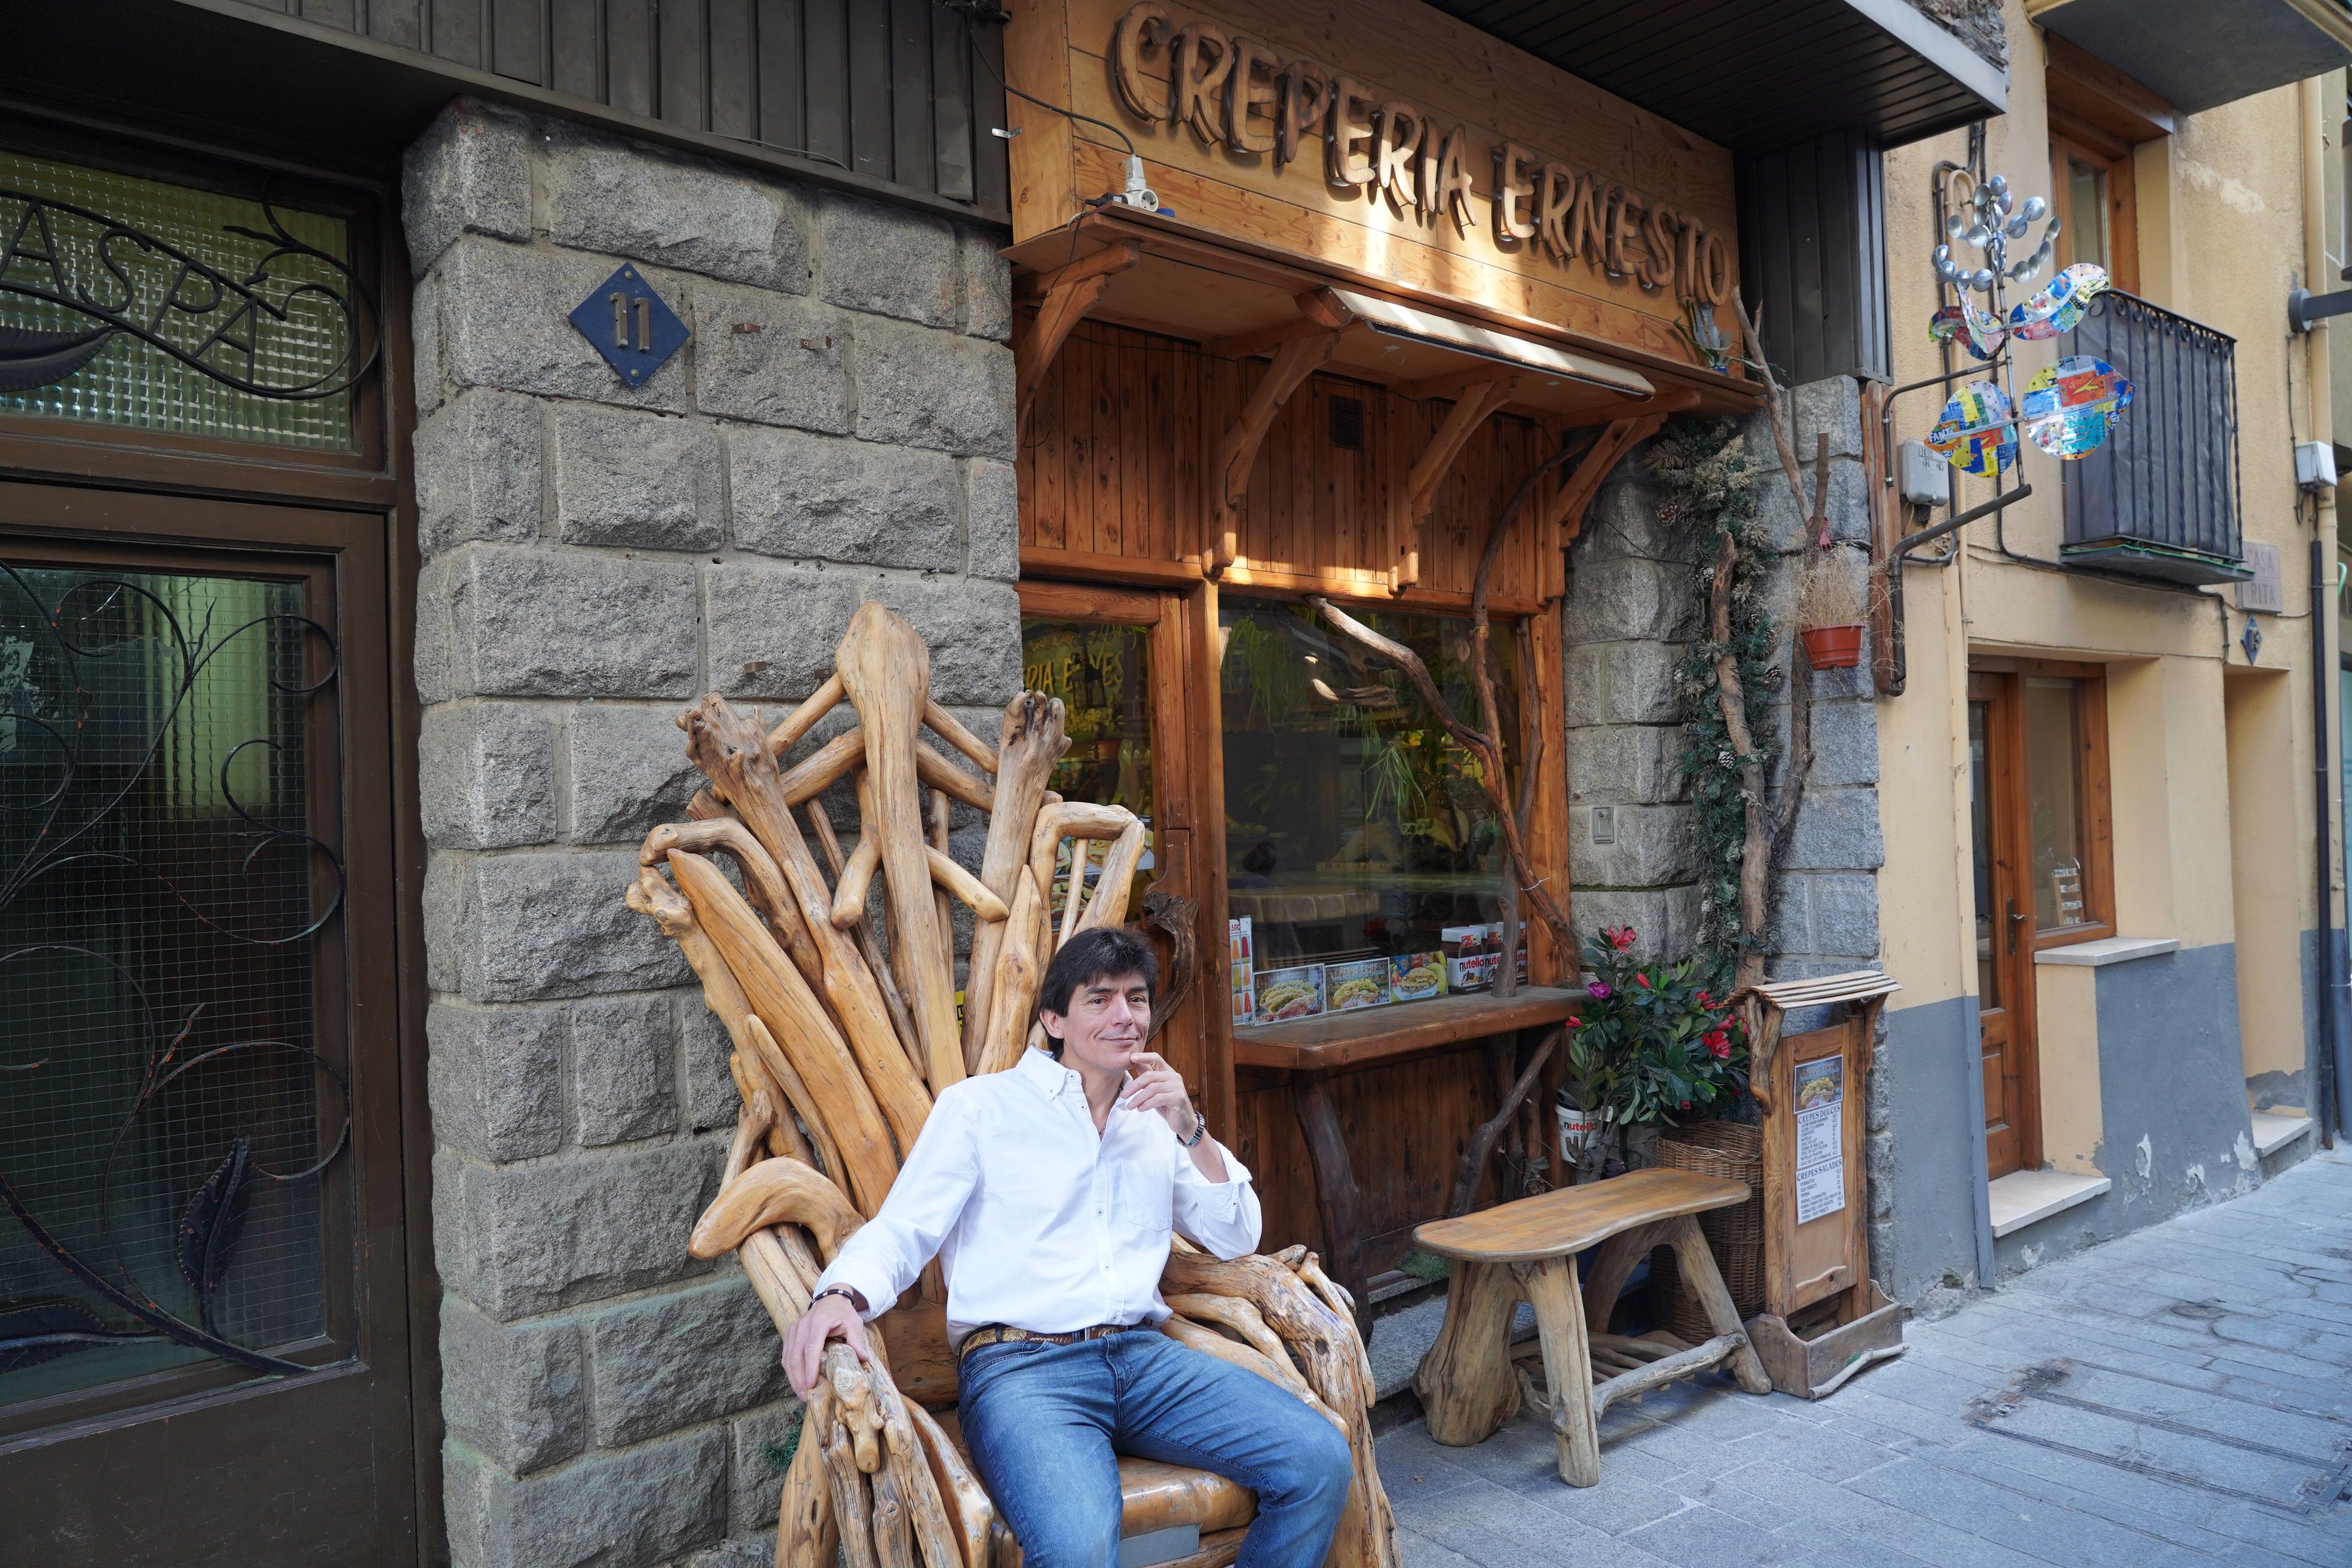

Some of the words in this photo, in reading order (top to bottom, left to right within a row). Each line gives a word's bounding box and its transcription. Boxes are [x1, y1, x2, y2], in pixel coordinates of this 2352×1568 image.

[1115, 1, 1478, 227] CREPERIA
[1497, 141, 1731, 306] ERNESTO
[610, 292, 650, 353] 11
[2247, 549, 2274, 572] CASA
[2250, 583, 2276, 605] RITA
[1459, 957, 1484, 970] nutella
[1485, 956, 1501, 968] nute
[1798, 1111, 1819, 1124] CREPES
[1820, 1105, 1840, 1117] DOLCES
[1797, 1168, 1818, 1181] CREPES
[1818, 1159, 1842, 1174] SALADES
